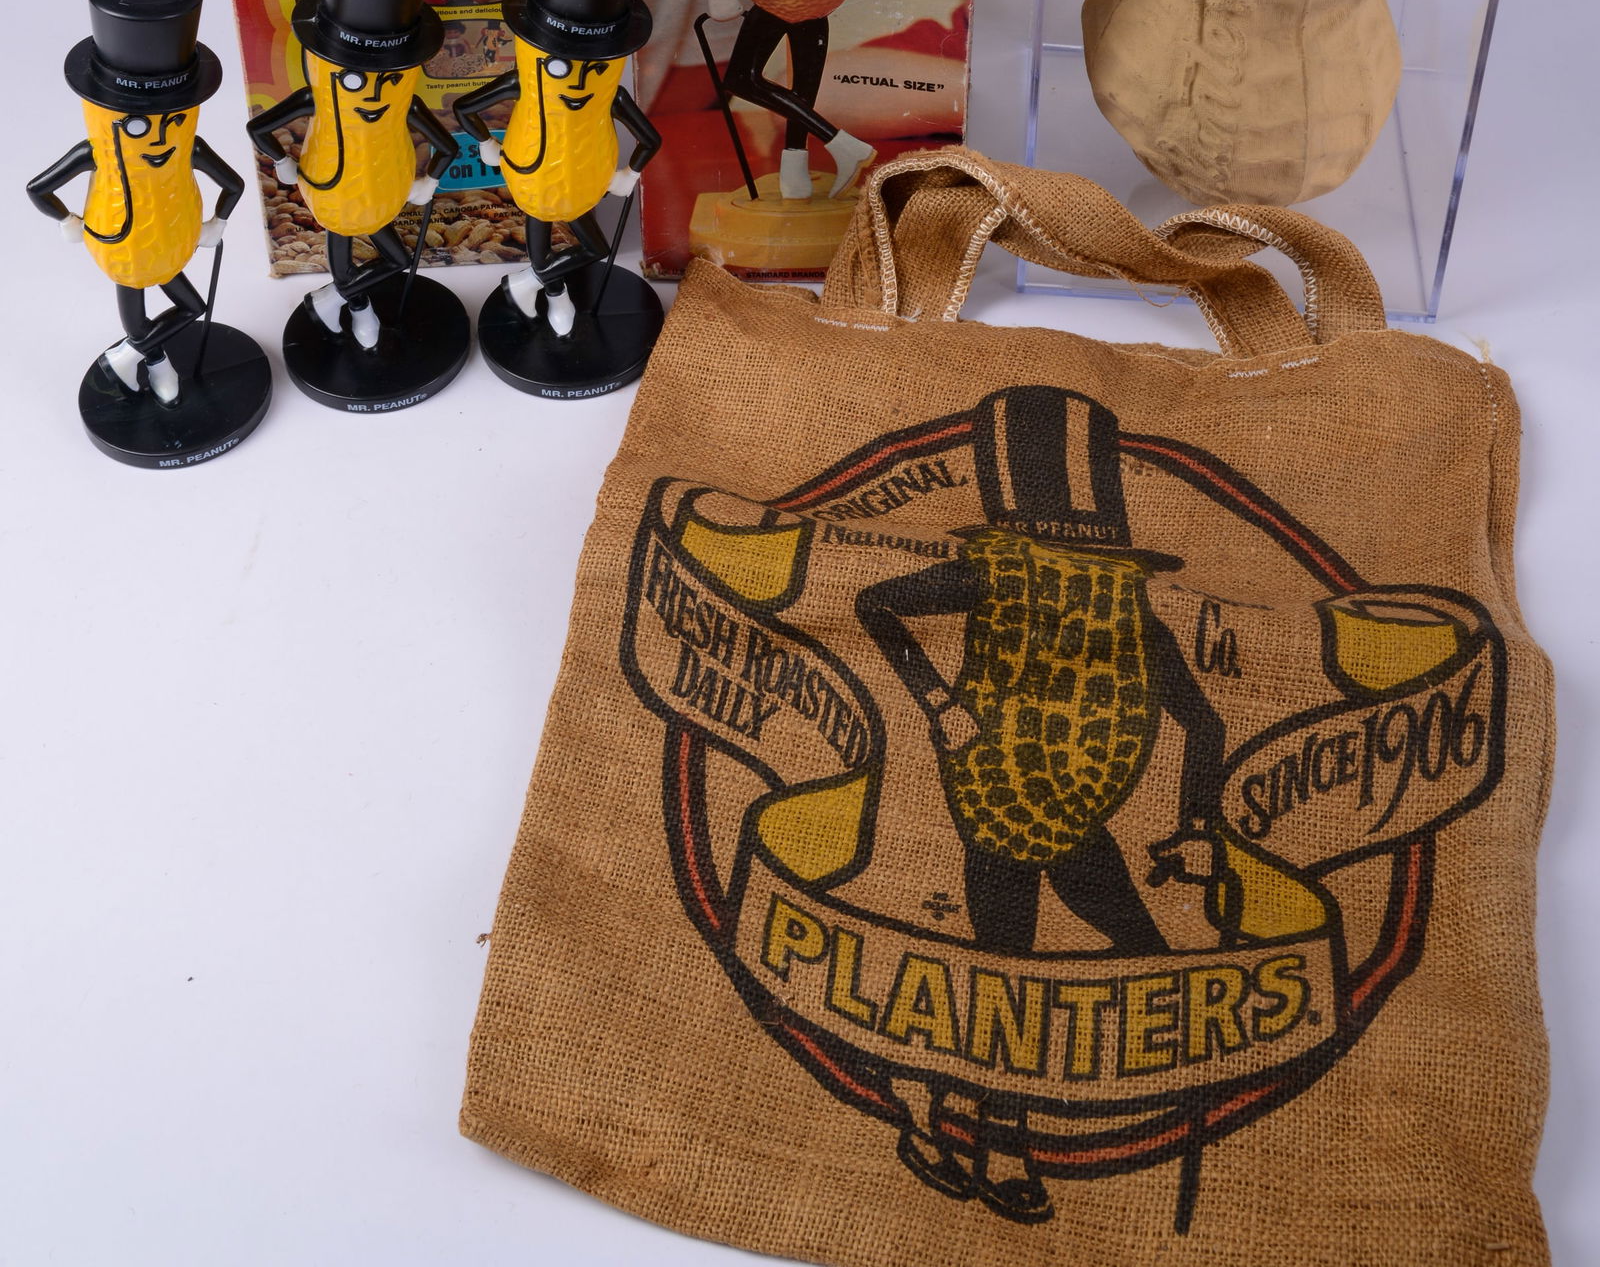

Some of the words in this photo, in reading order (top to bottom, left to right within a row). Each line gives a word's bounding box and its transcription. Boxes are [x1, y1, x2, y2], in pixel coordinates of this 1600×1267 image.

[546, 16, 568, 32] MR.
[570, 23, 617, 36] PEANUT
[339, 31, 362, 46] MR.
[364, 34, 411, 49] PEANUT
[115, 77, 142, 89] MR.
[144, 73, 189, 89] PEANUT
[446, 81, 471, 89] peanut
[449, 163, 473, 179] on
[443, 205, 479, 215] CANOGA
[746, 271, 790, 279] STANDARD
[541, 388, 565, 398] MR.
[346, 403, 371, 412] MR.
[159, 459, 184, 468] MR.
[812, 459, 968, 524] ORIGINAL
[646, 539, 740, 670] FRESH
[740, 626, 871, 770] ROASTED
[670, 639, 782, 743] DAILY
[1238, 731, 1360, 840] SINCE
[1357, 661, 1485, 838] 1906
[760, 891, 1312, 1082] PLANTERS
